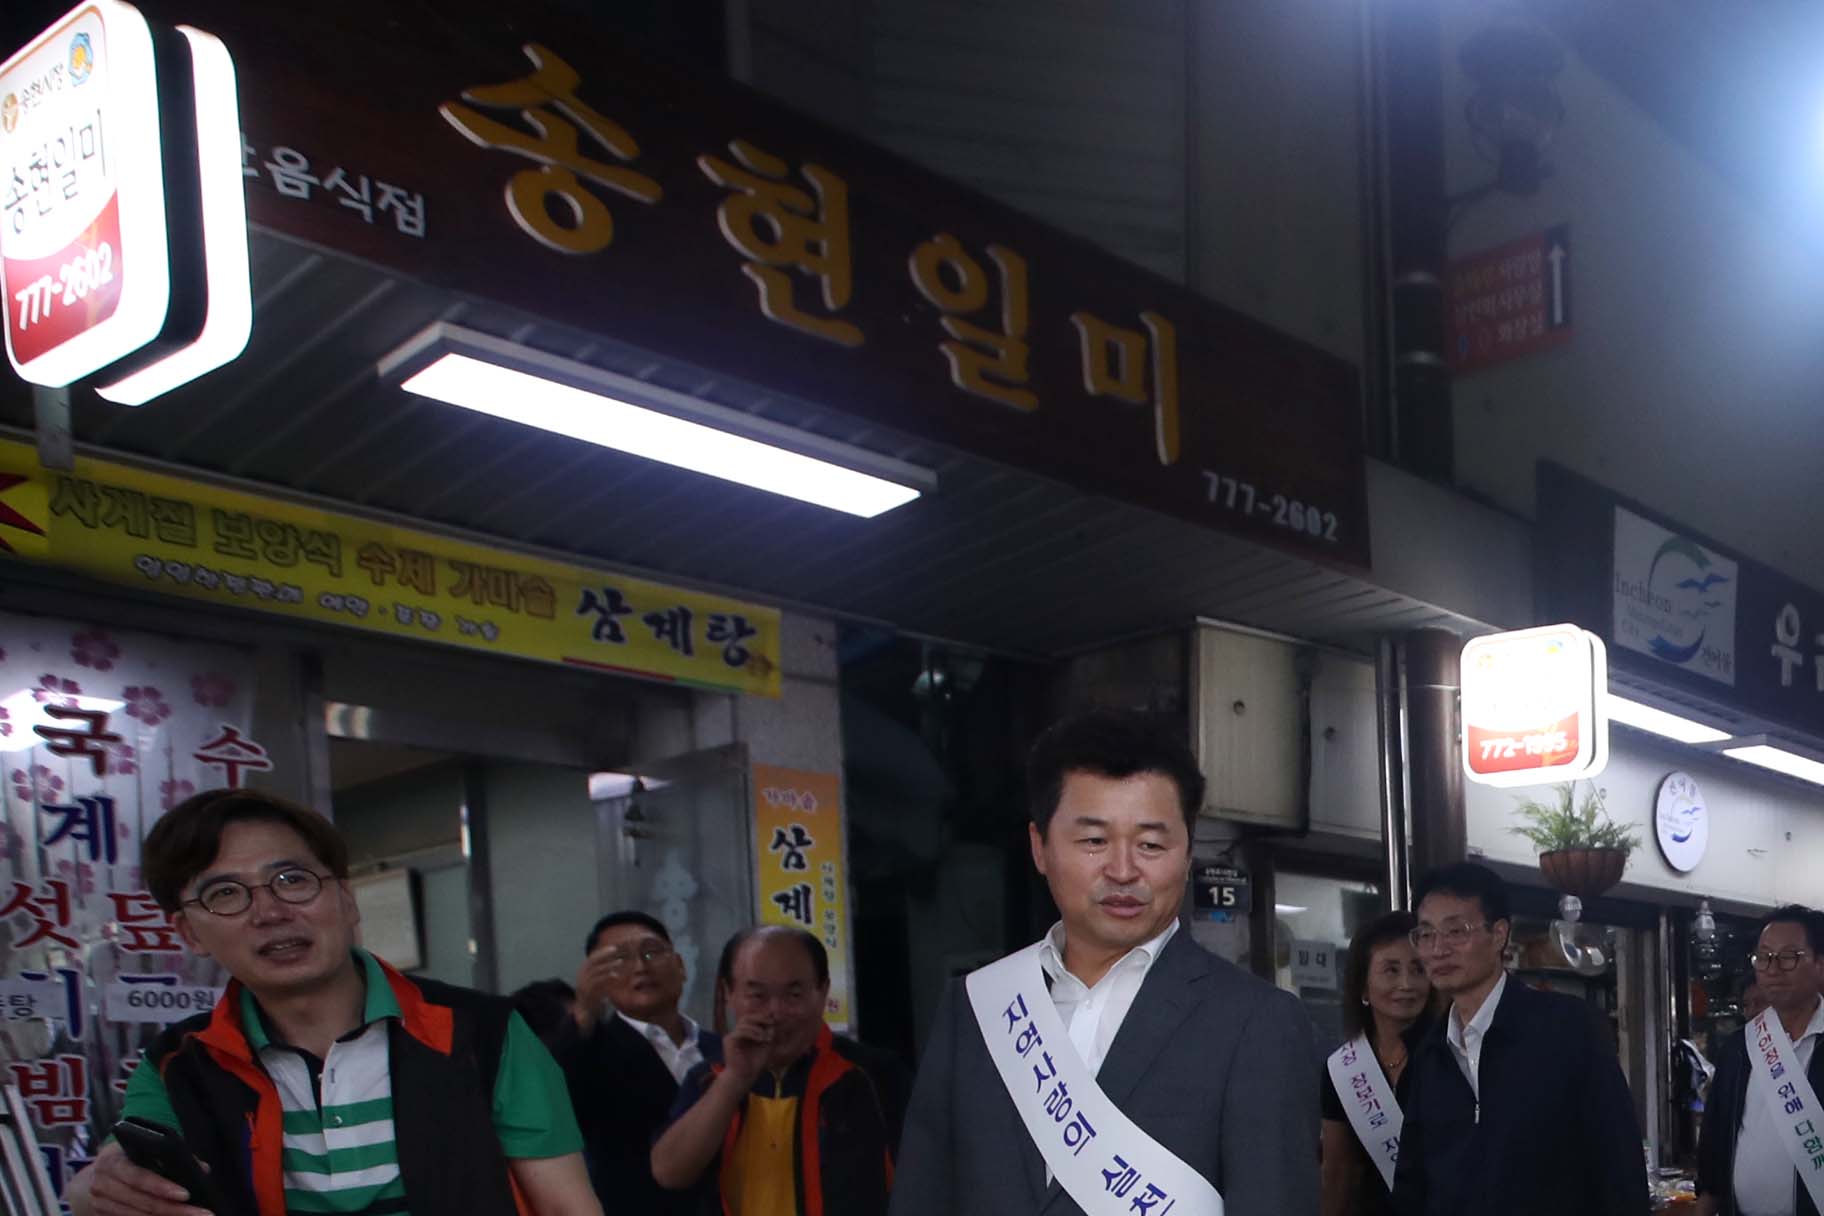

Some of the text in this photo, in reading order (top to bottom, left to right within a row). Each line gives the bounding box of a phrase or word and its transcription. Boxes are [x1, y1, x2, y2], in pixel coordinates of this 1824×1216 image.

[16, 241, 113, 332] 777-2602
[438, 43, 1181, 466] 송현일미
[1203, 469, 1339, 543] 777-2602
[50, 476, 197, 547] 사계절
[212, 508, 342, 578] 보양식
[575, 587, 757, 668] 삼계탕
[1208, 886, 1236, 907] 15
[1001, 993, 1096, 1157] 지역사랑의
